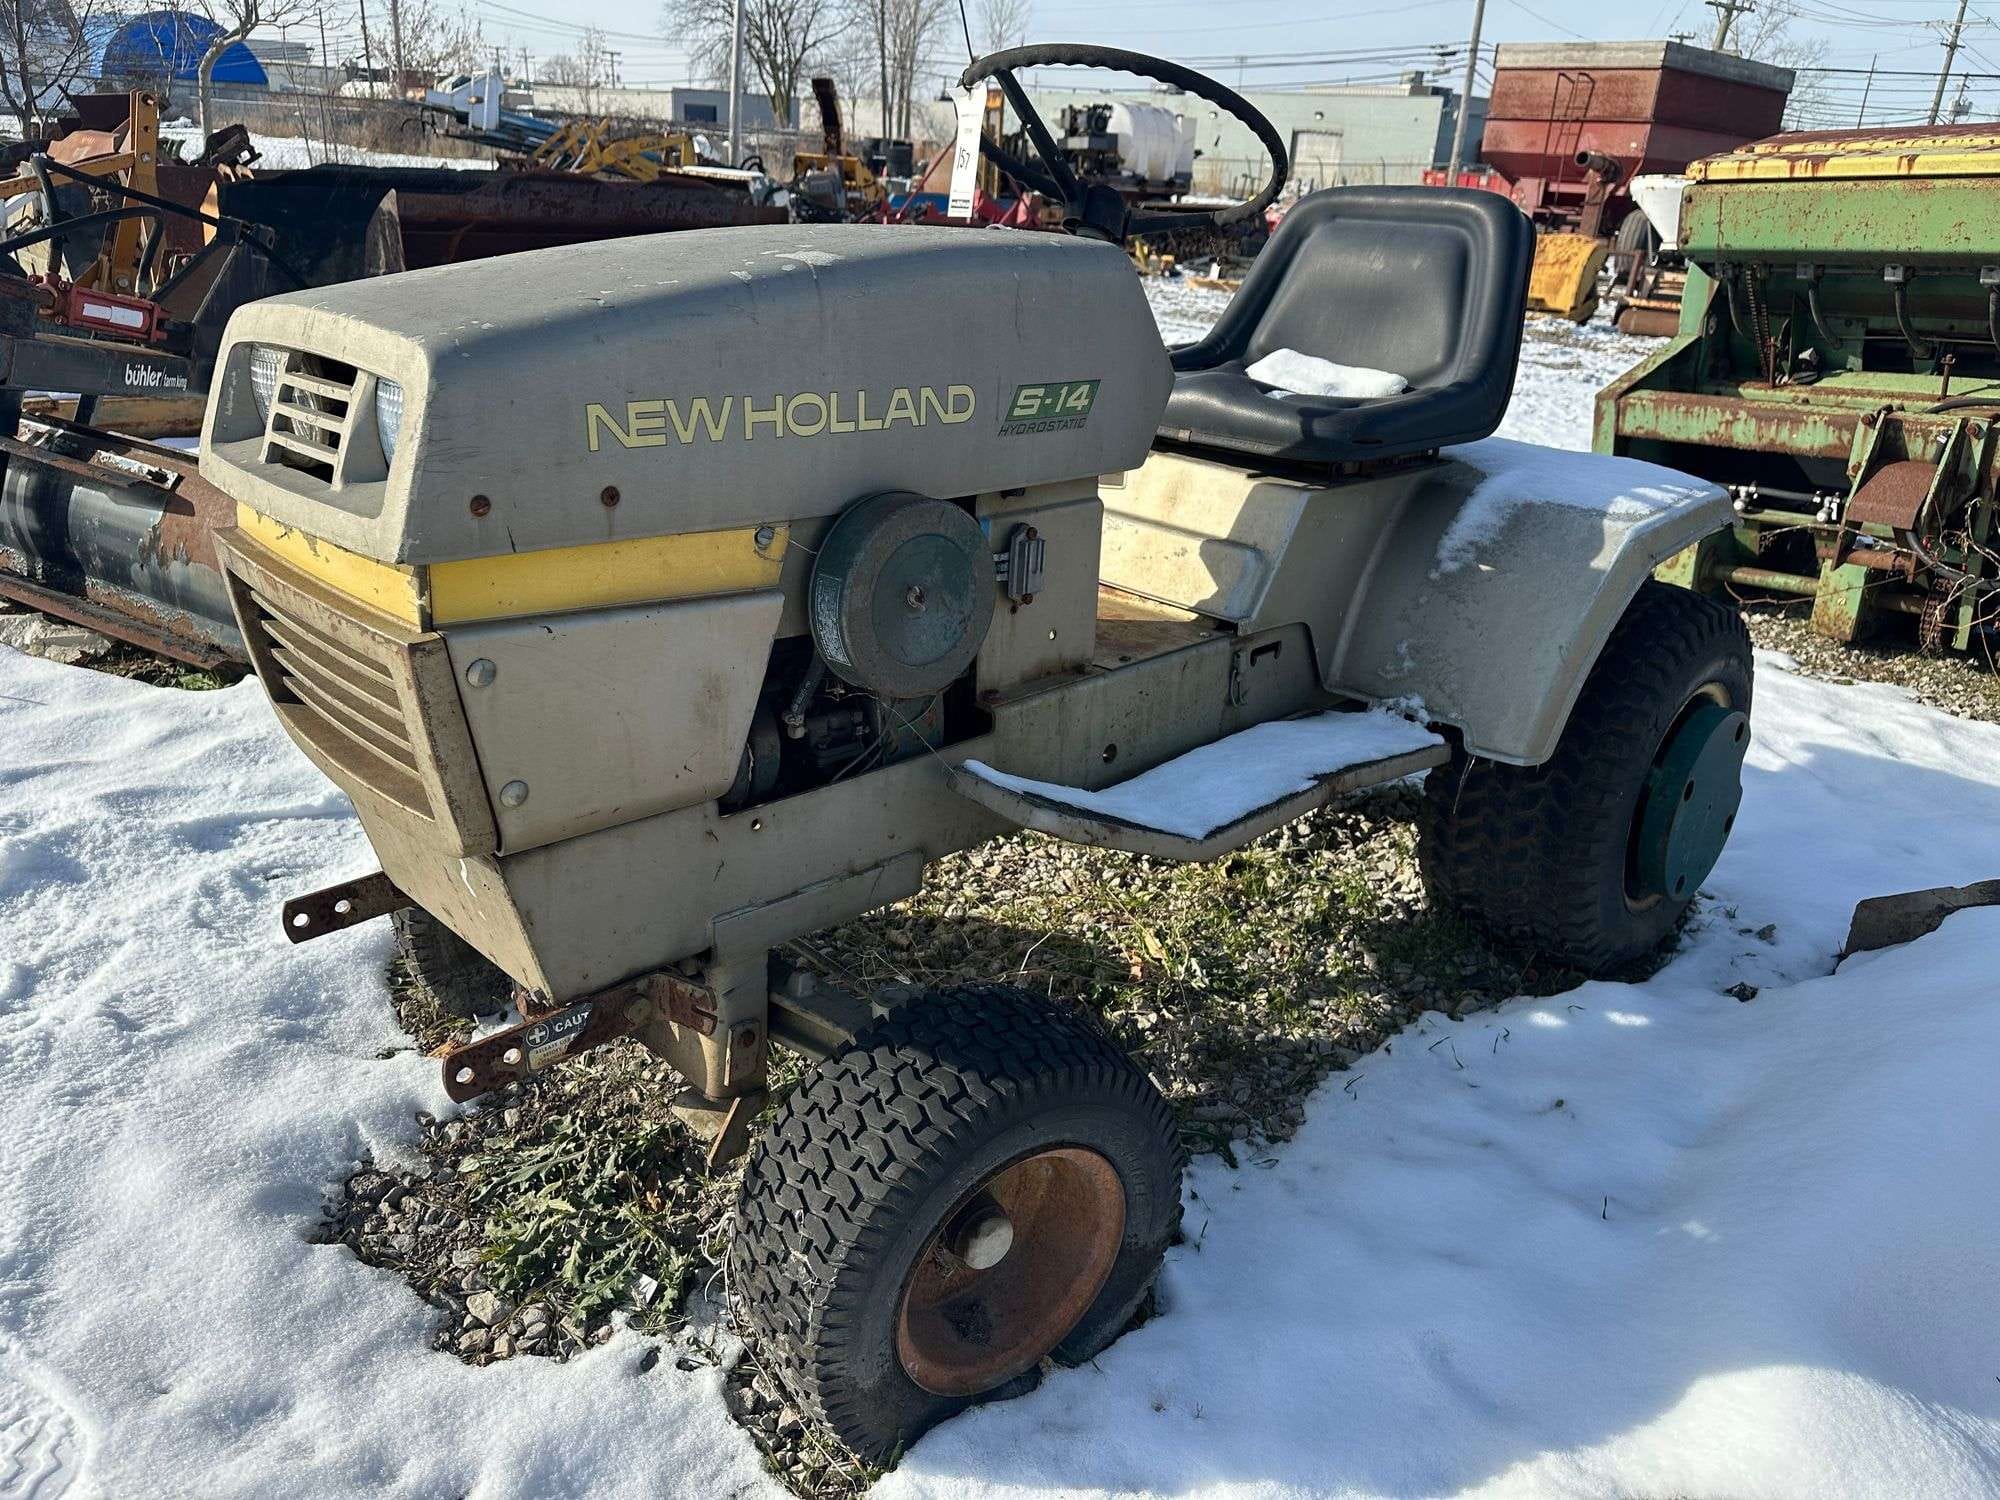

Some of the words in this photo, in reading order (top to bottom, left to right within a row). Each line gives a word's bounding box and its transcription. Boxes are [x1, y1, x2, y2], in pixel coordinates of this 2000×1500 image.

[1012, 384, 1091, 416] S-14
[585, 395, 734, 452] NEW
[743, 384, 976, 442] HOLLAND
[998, 418, 1087, 438] HYDROSTATIC
